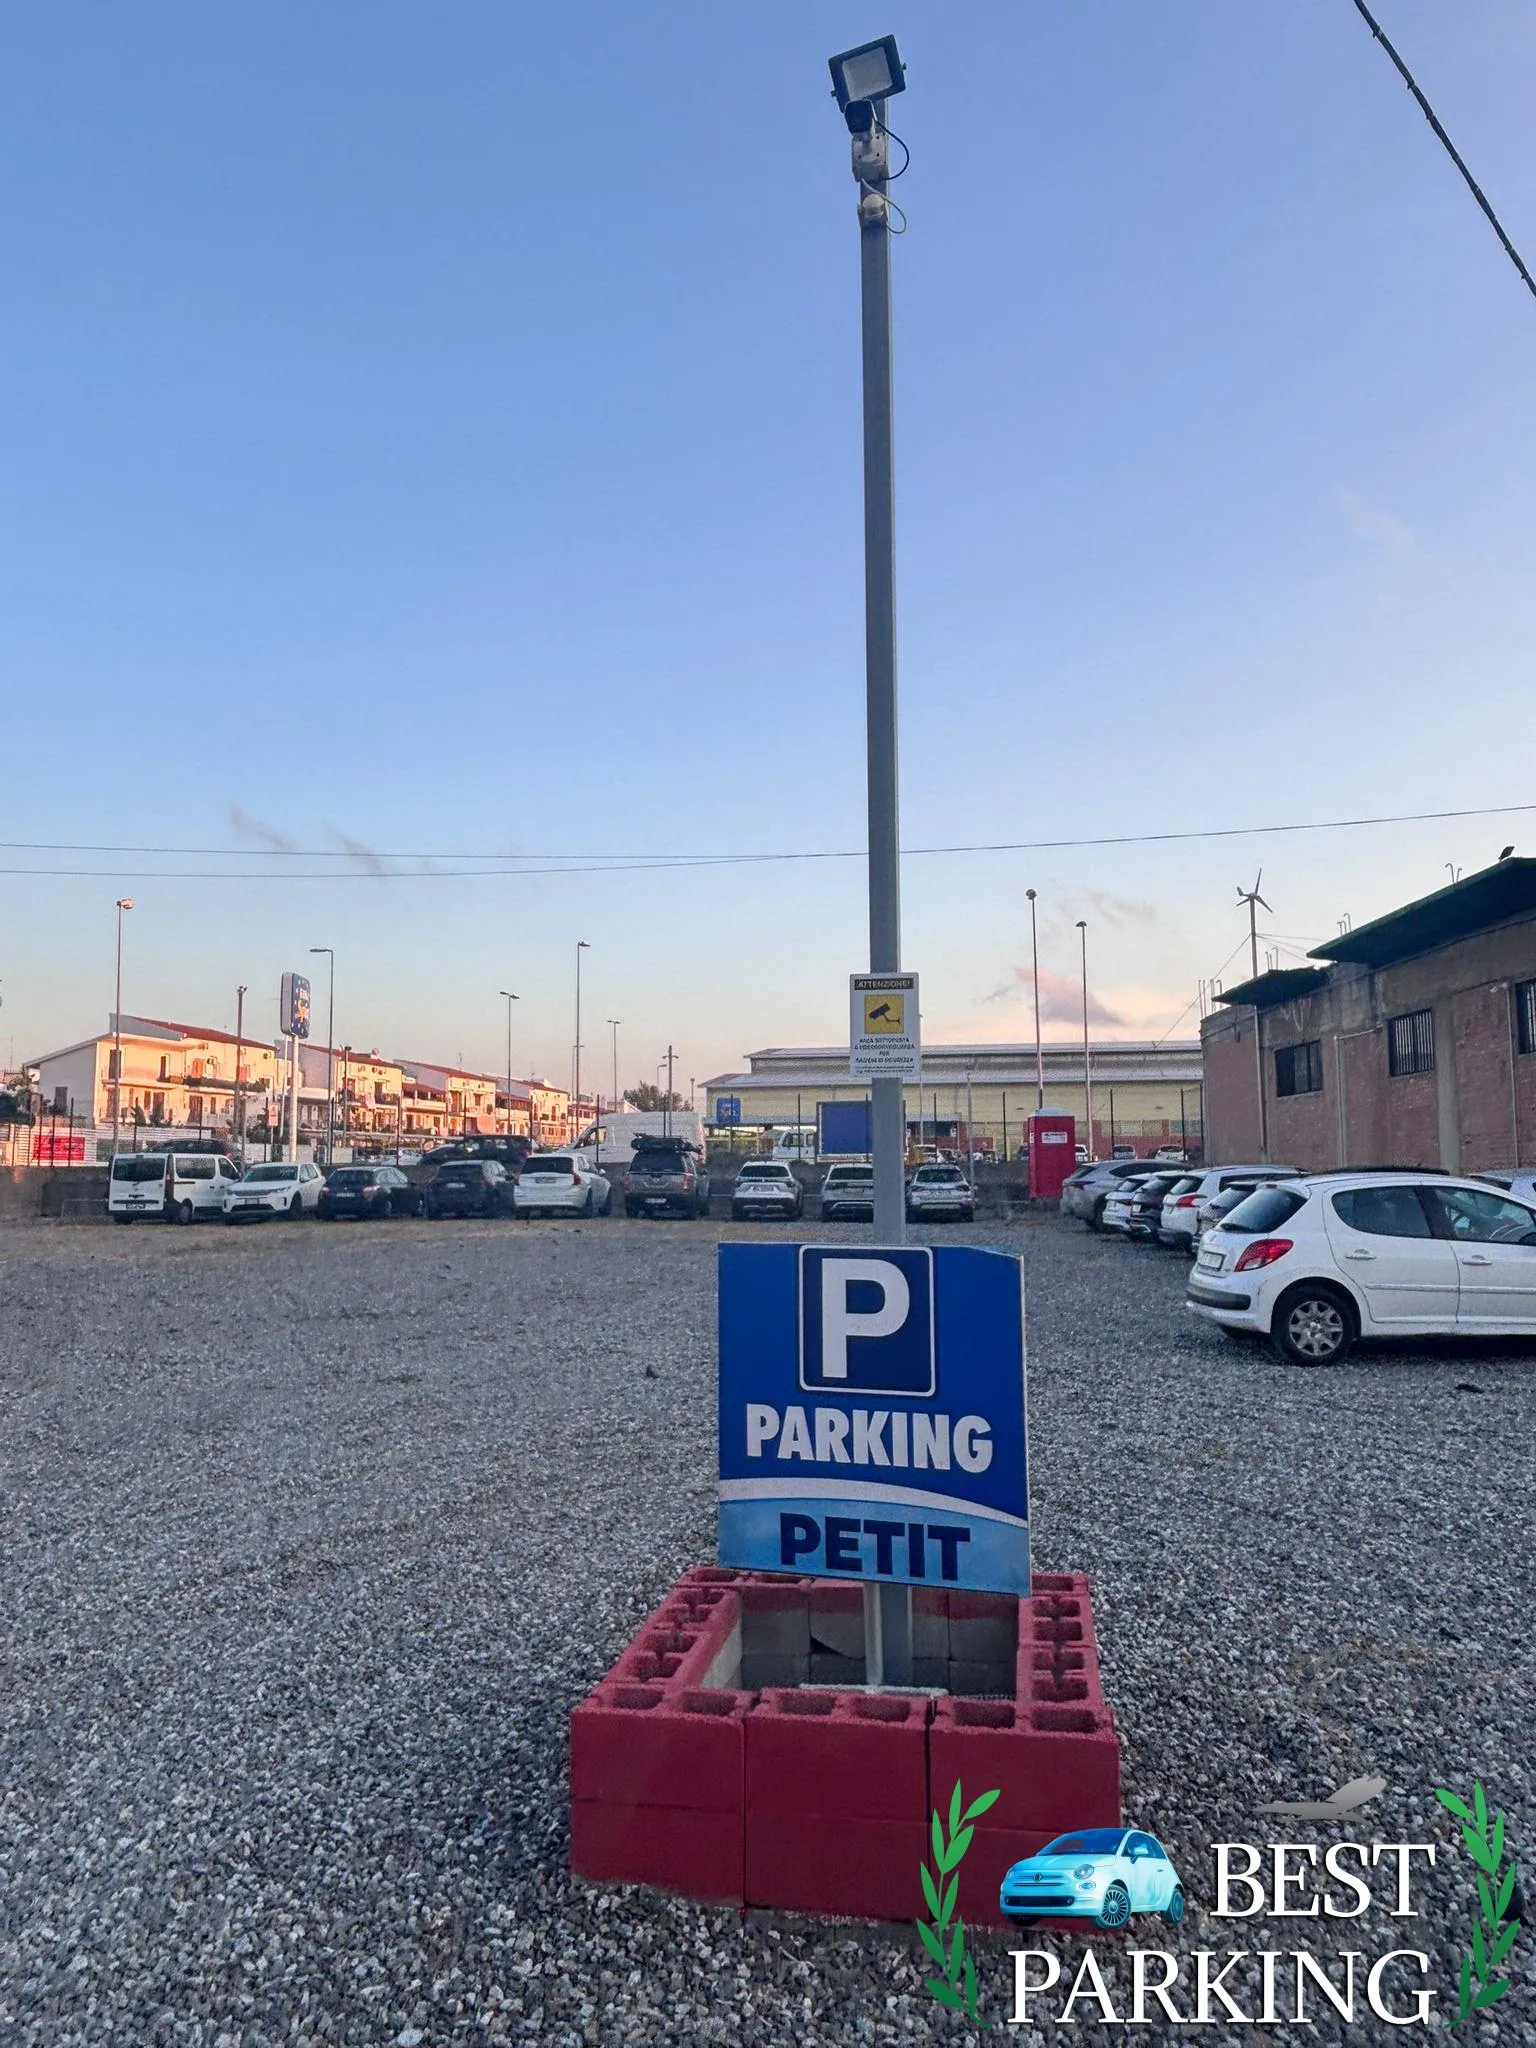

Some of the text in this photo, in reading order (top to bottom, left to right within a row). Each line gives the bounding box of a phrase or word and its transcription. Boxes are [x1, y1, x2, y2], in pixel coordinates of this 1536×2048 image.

[822, 1258, 910, 1378] P
[746, 1403, 993, 1473] PARKING
[780, 1512, 971, 1581] PETIT
